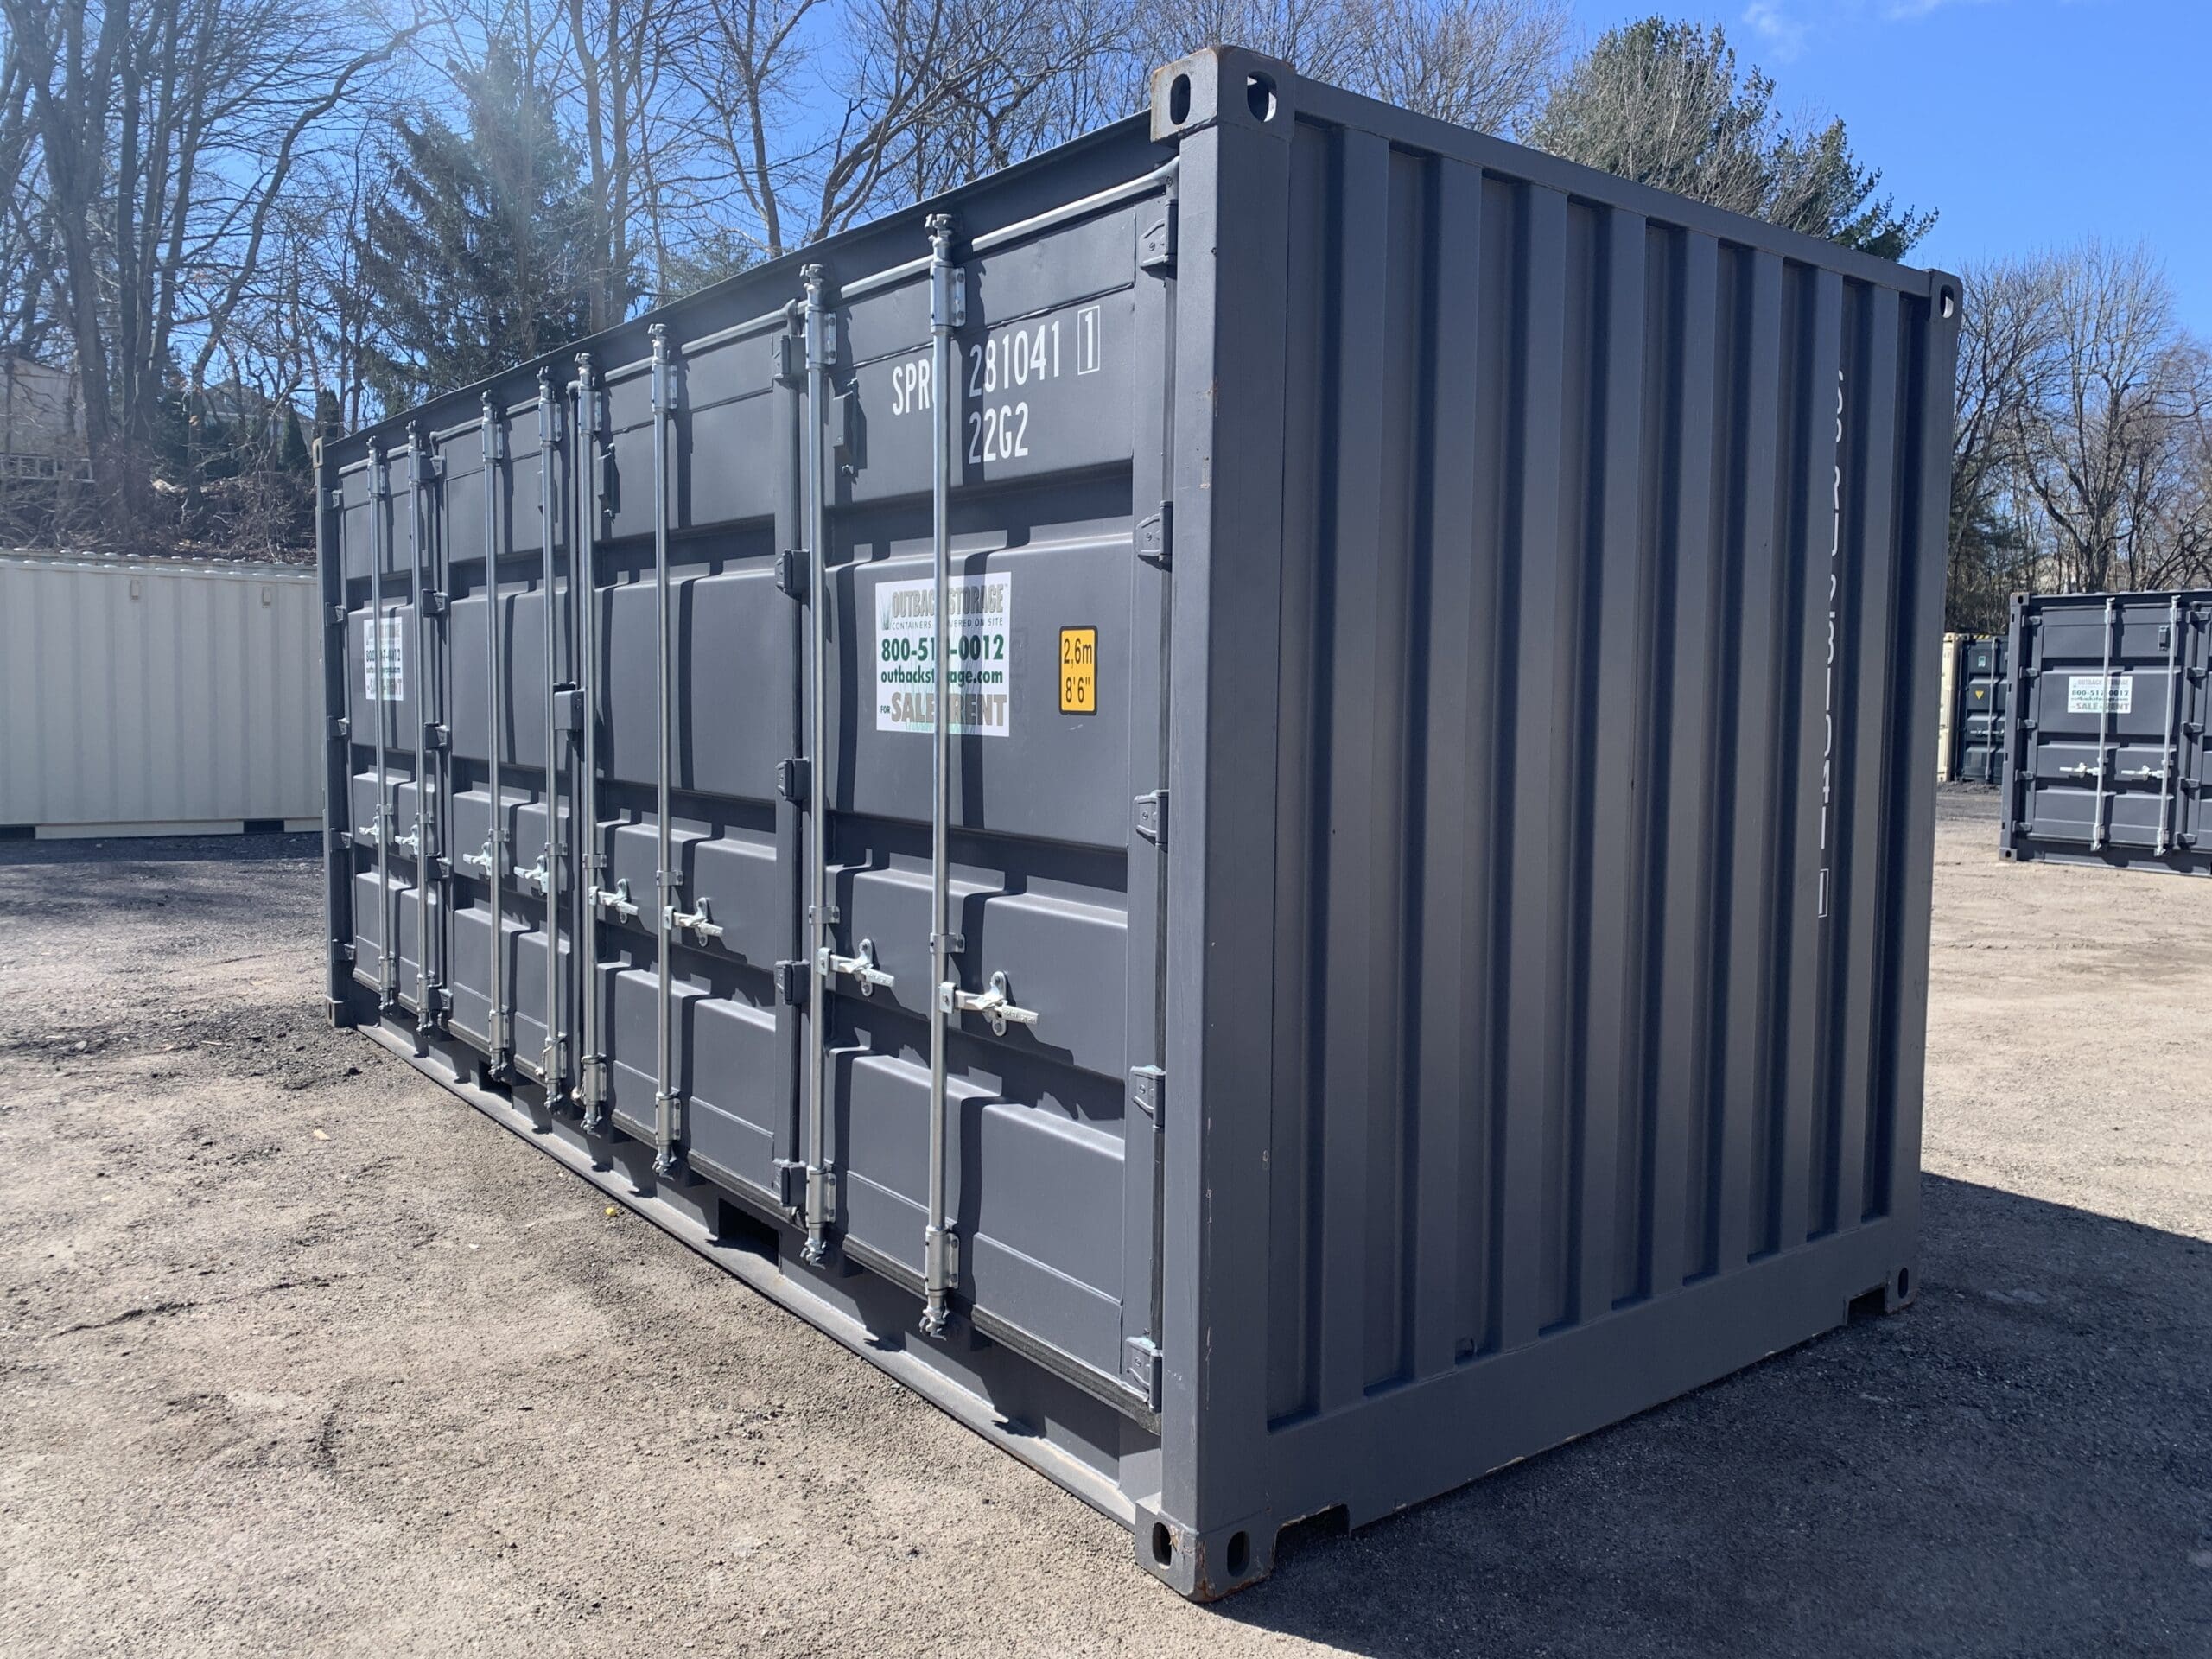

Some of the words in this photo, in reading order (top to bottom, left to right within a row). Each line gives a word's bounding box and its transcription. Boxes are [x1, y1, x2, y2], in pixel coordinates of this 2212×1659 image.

[893, 359, 935, 416] SPR
[969, 320, 1059, 397] 281041
[968, 401, 1028, 464] 22G2
[892, 588, 935, 618] OUTBAC
[891, 620, 932, 631] CONTAINERS
[974, 617, 984, 627] ON
[988, 617, 1003, 626] SITE
[881, 634, 1004, 662] 800-51-0012
[880, 664, 1003, 688] outbackstage.com
[880, 704, 890, 714] FOR
[891, 691, 935, 723] SALE
[948, 693, 1007, 726] RENT
